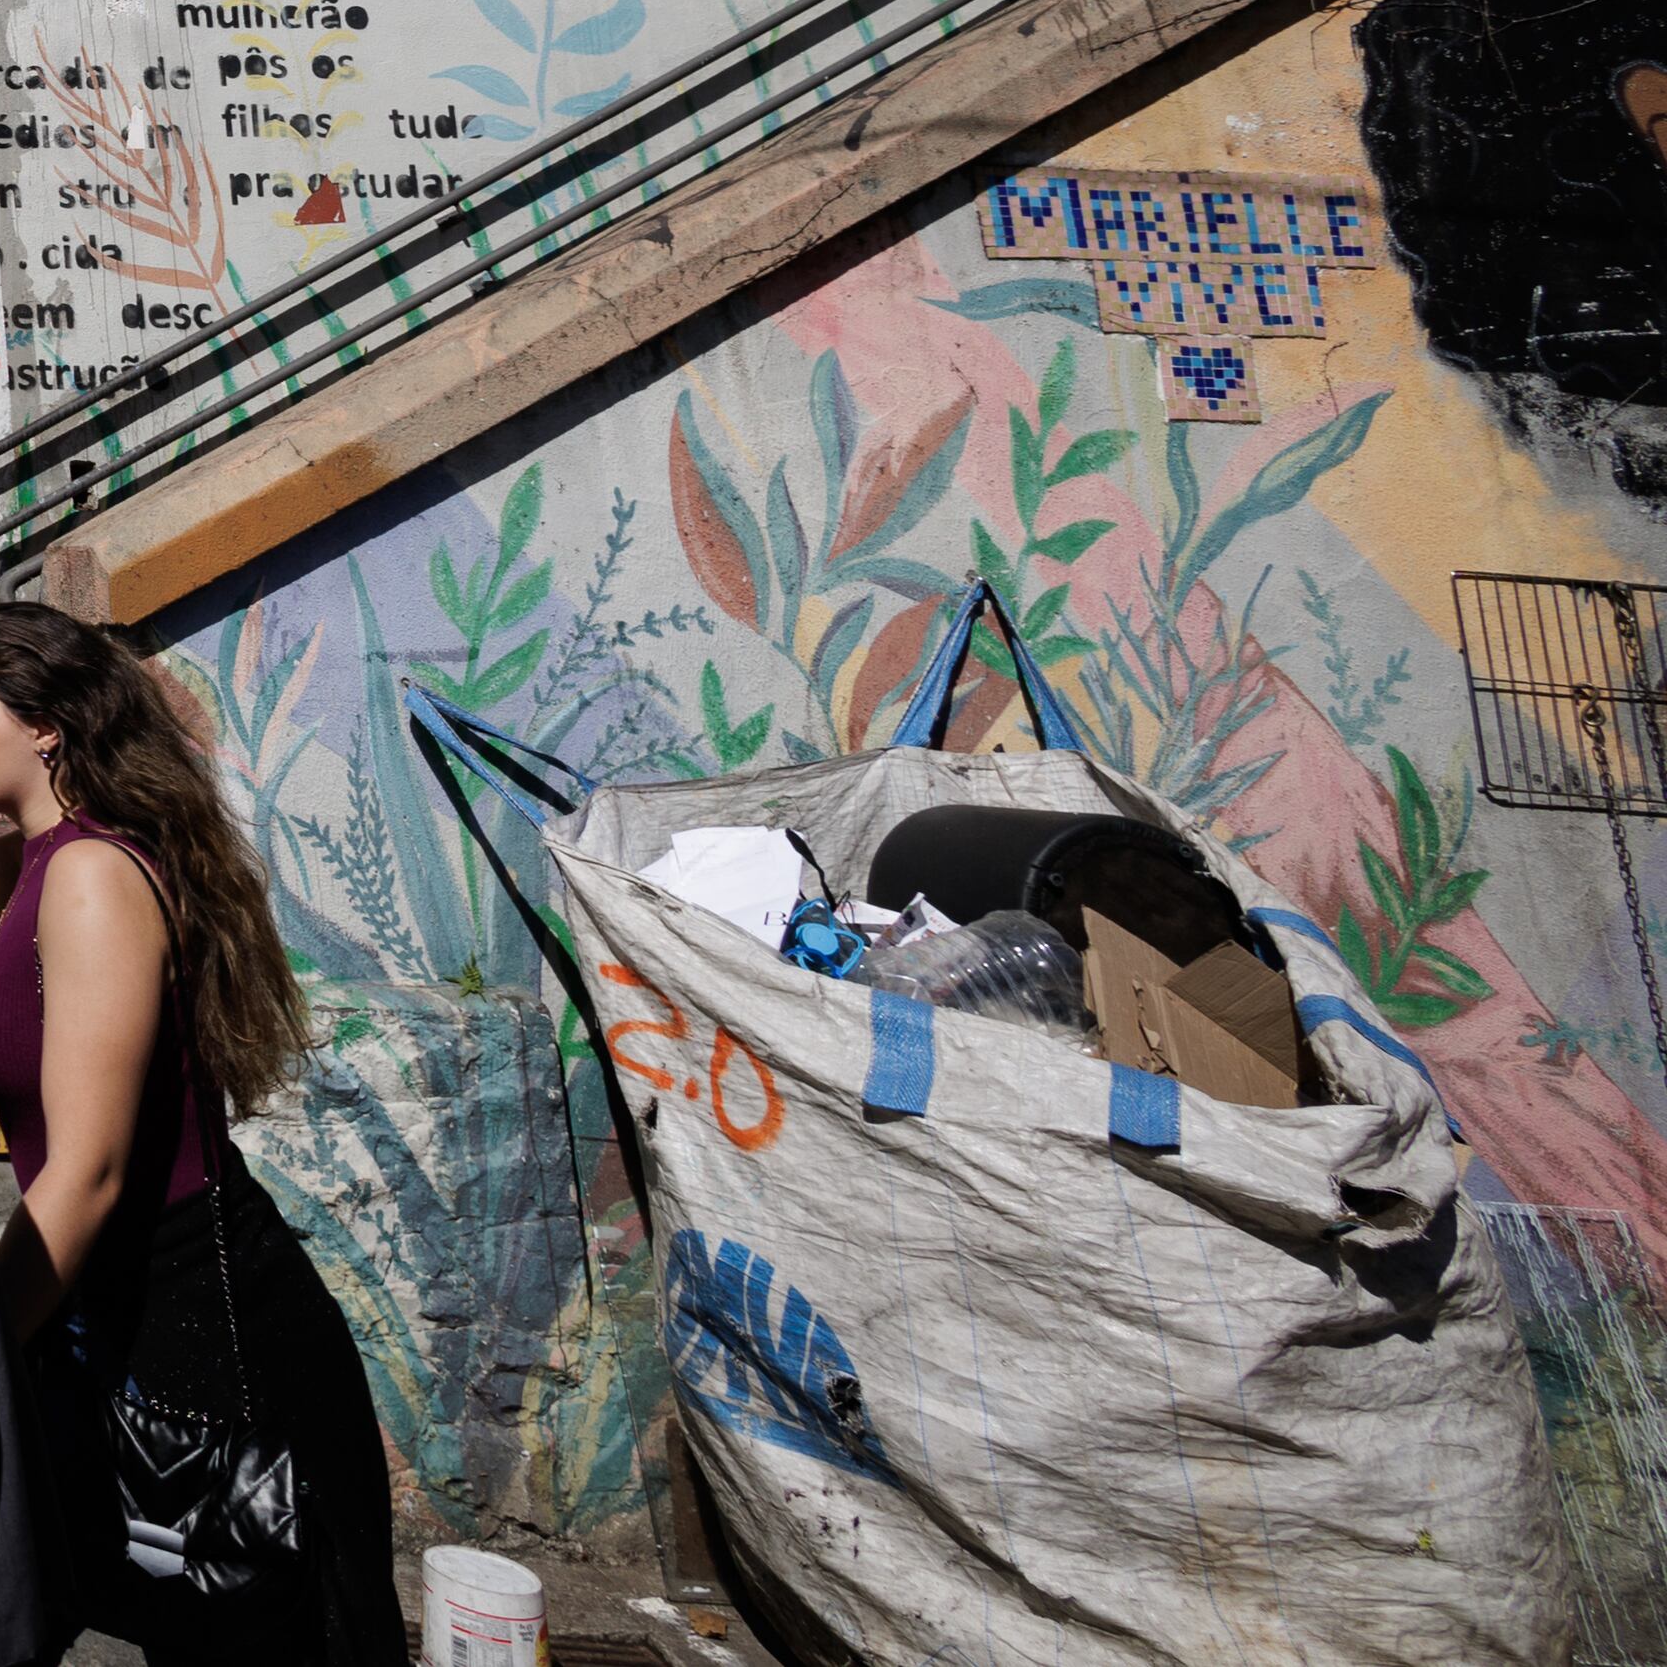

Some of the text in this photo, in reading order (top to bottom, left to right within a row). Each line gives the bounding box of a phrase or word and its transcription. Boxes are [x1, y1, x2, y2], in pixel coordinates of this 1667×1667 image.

[60, 56, 109, 91] da
[143, 56, 192, 91] de
[218, 46, 356, 86] pôs os
[220, 104, 485, 140] filhos tudo
[229, 170, 294, 206] pra
[986, 176, 1365, 258] MARIELLE
[41, 235, 124, 271] cida
[121, 294, 215, 331] desc
